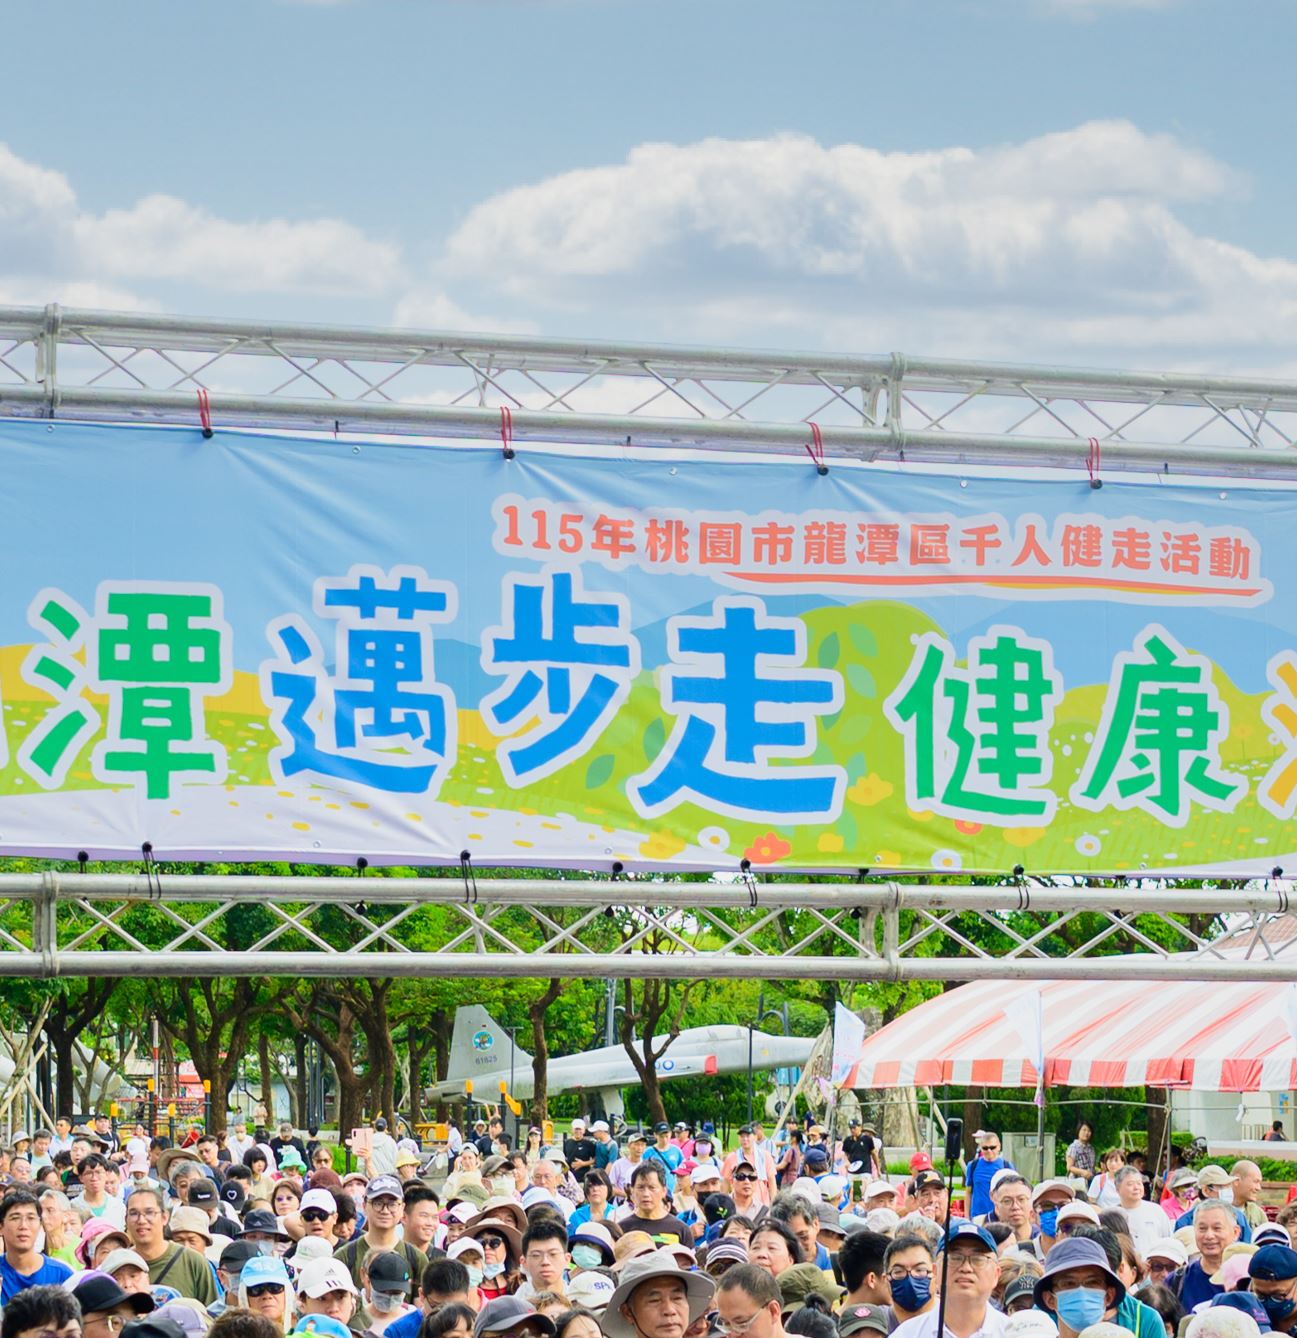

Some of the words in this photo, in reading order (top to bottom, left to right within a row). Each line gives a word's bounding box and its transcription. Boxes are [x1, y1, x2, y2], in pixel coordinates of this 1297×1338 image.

[503, 505, 1252, 580] 115年桃園市龍潭區千人健走活動
